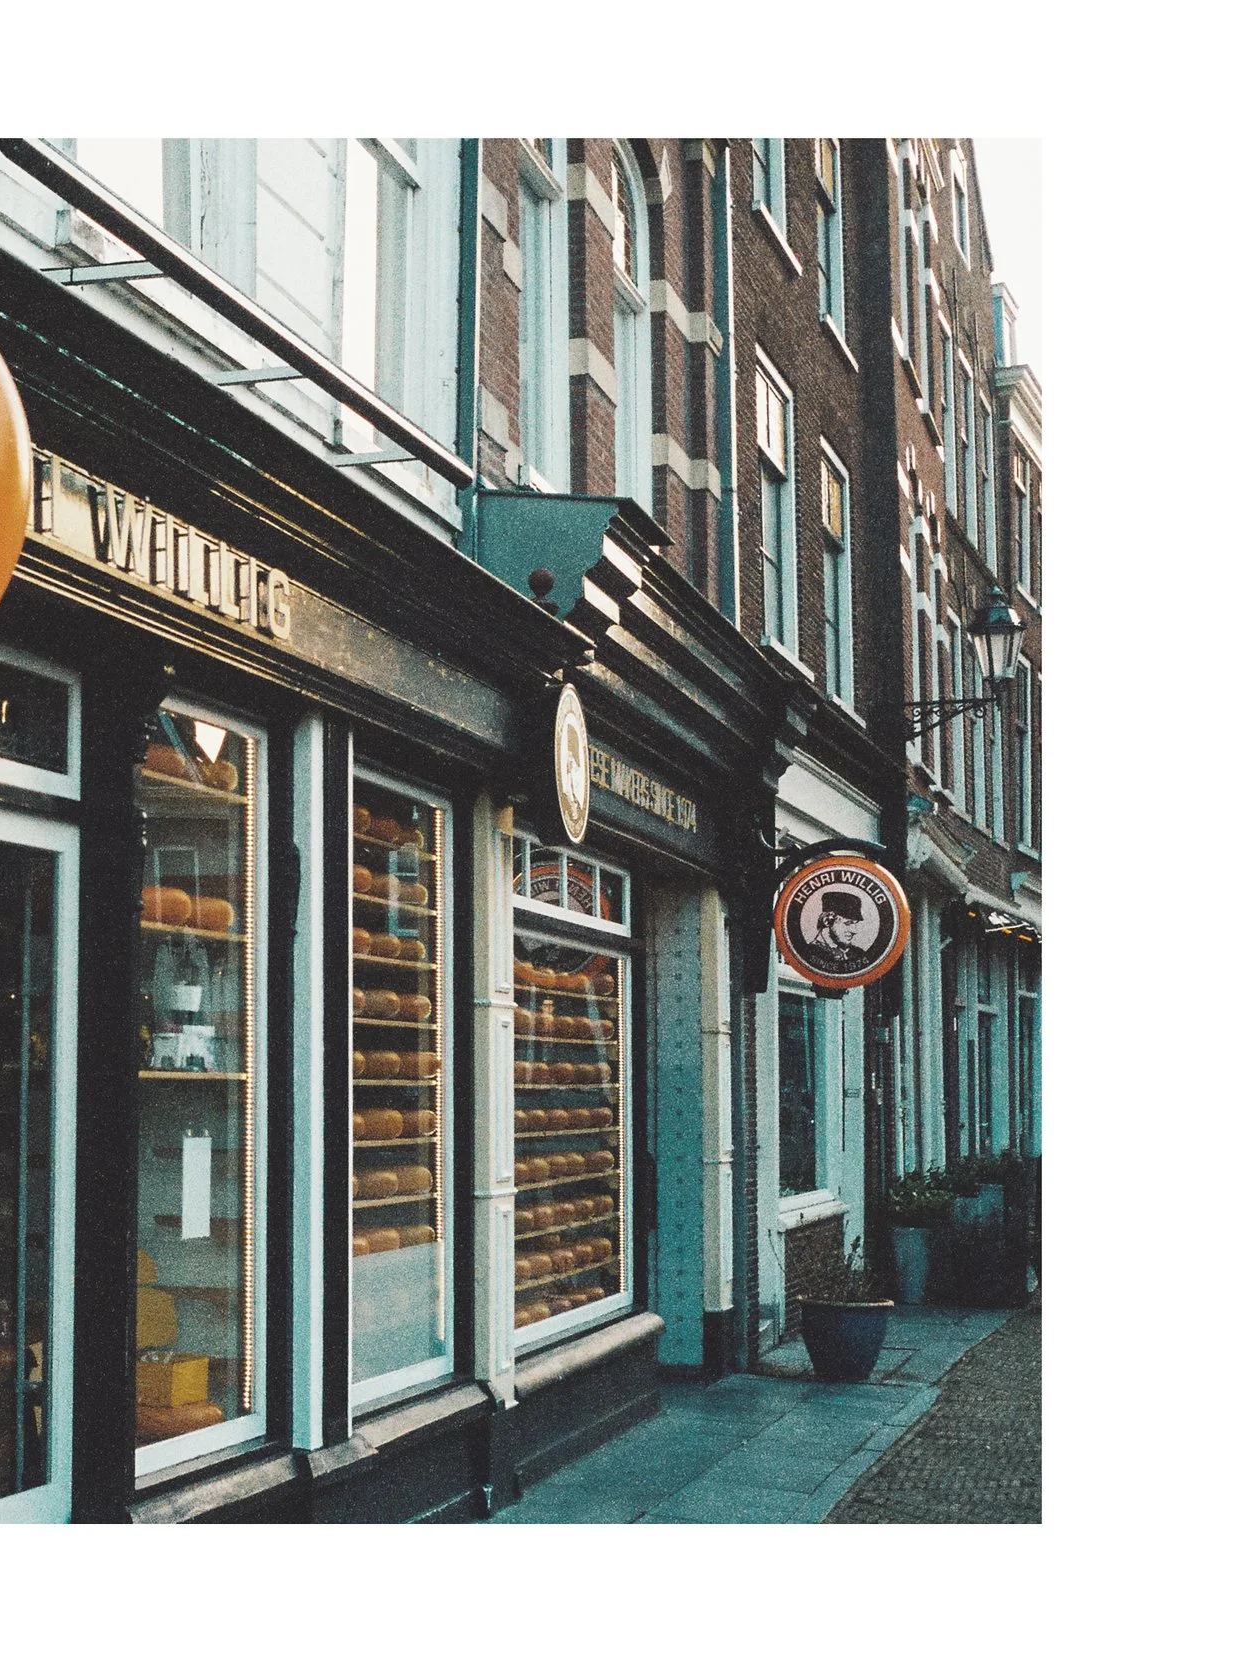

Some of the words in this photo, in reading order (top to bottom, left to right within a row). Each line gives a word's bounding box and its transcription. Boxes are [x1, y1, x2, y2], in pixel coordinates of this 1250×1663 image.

[105, 480, 291, 640] WILLIG
[794, 871, 836, 905] HENRI
[841, 870, 887, 906] WILLIG
